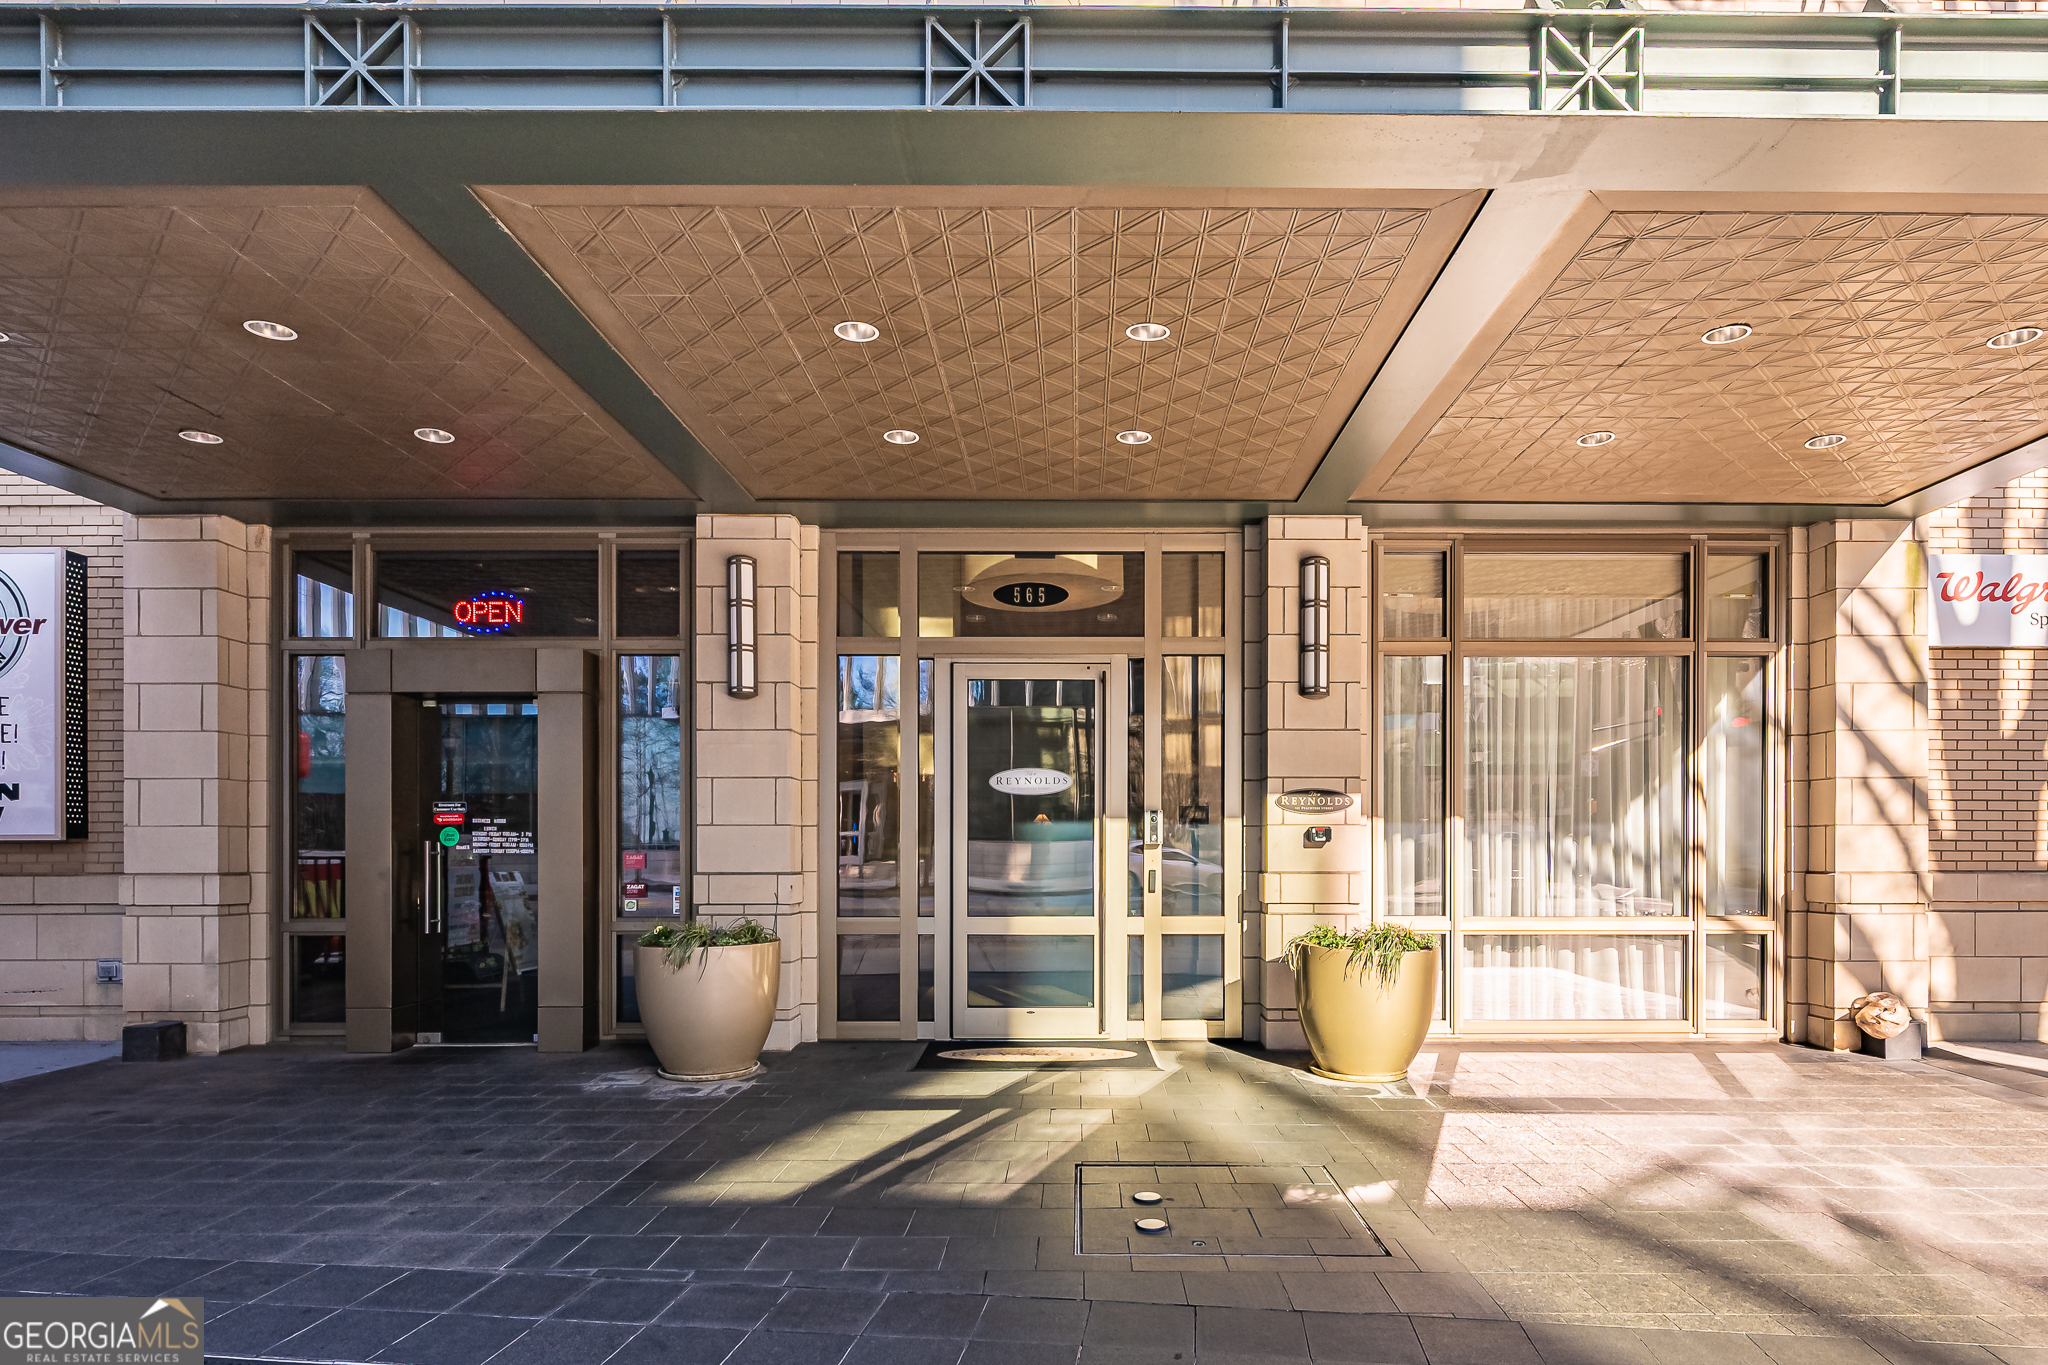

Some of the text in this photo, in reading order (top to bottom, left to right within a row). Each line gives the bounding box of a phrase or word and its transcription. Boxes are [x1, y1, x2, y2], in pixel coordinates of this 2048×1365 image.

[1013, 587, 1045, 603] 565
[454, 600, 523, 623] OPEN
[996, 776, 1068, 785] REYNOLDS
[1281, 796, 1351, 806] REYNOLDS
